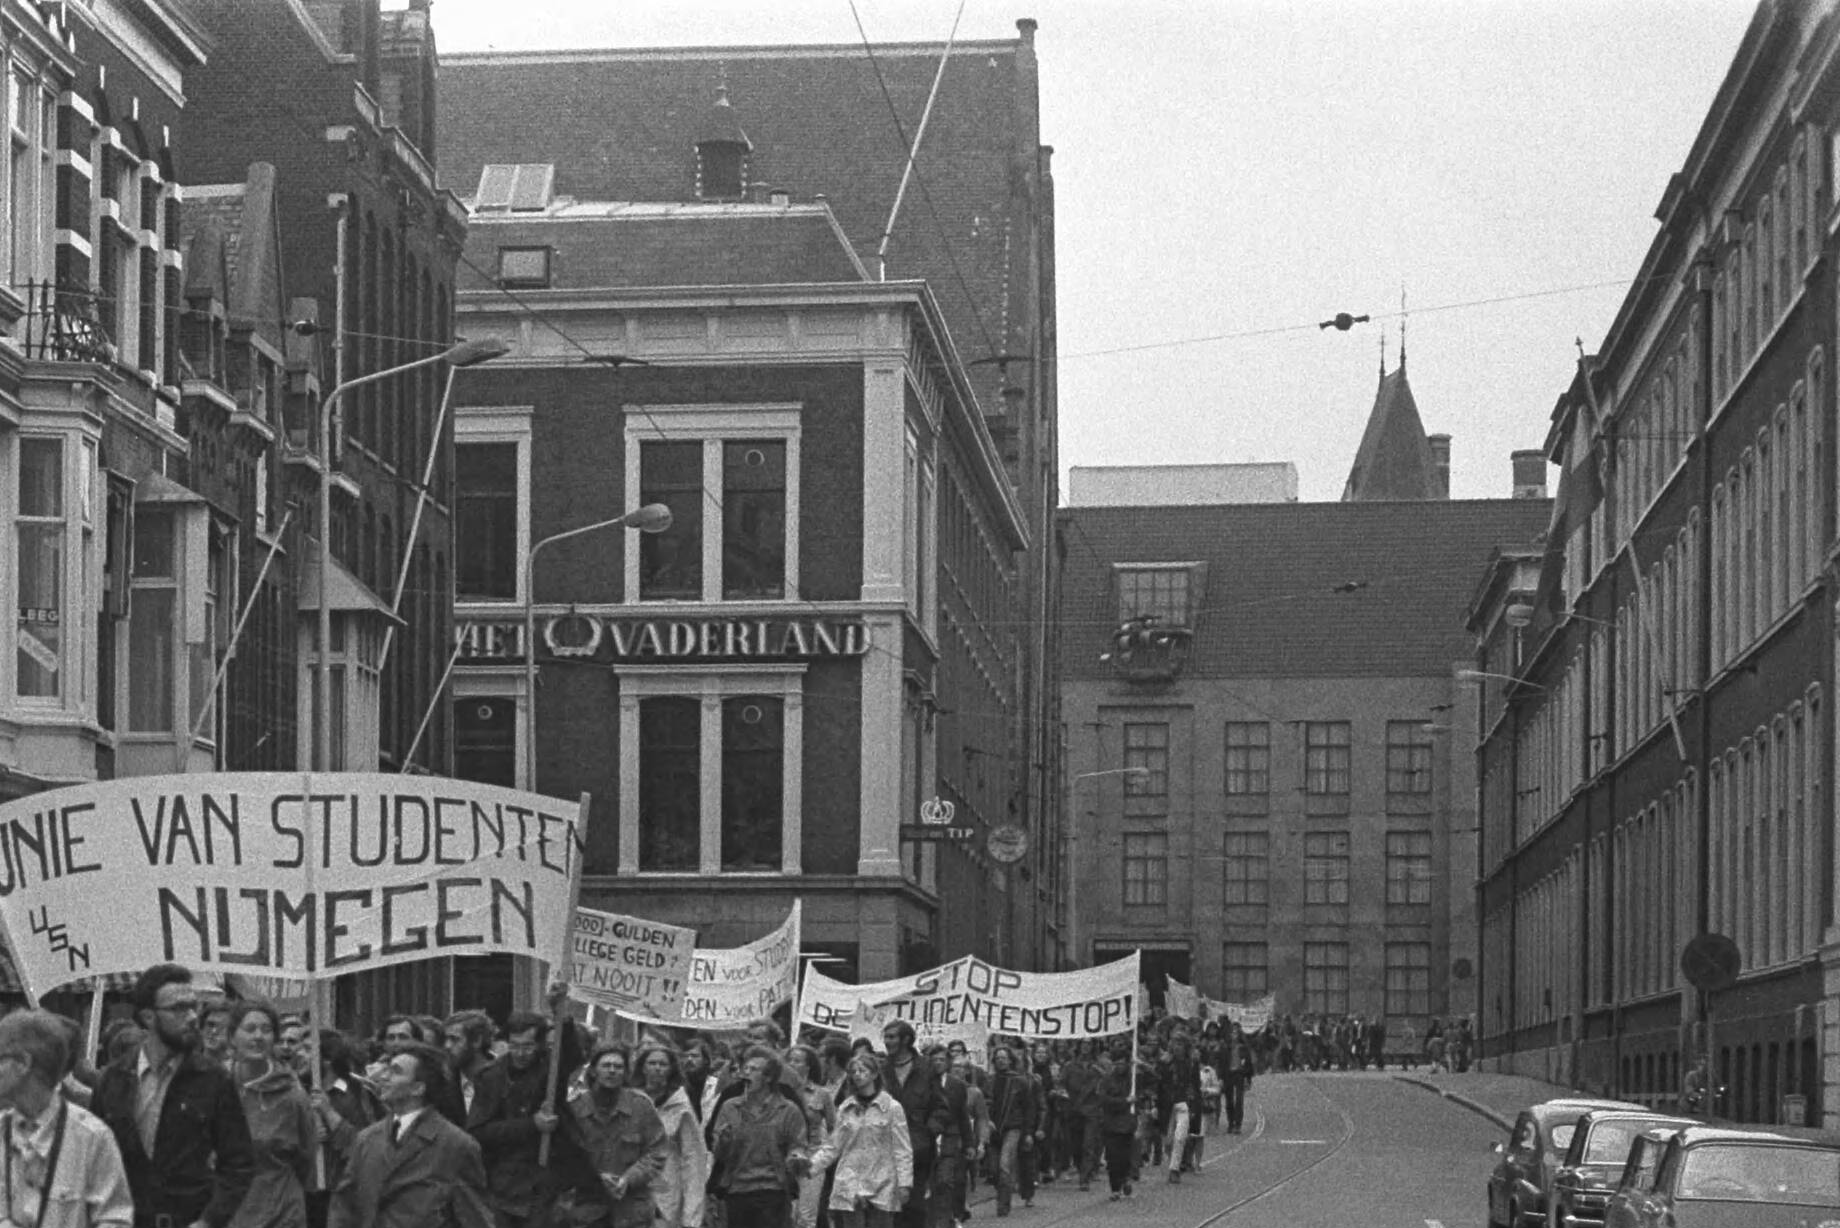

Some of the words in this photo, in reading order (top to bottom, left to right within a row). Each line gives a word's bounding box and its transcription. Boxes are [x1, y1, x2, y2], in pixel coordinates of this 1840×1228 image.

[610, 619, 872, 657] VADERLAND
[130, 793, 242, 866] VAN
[947, 827, 975, 839] TIP
[157, 878, 536, 973] NIJMEGEN
[612, 920, 676, 949] GULDEN
[623, 946, 665, 968] GELD
[593, 966, 658, 998] NOOIT
[912, 957, 1022, 998] STOP
[872, 992, 1133, 1035] TUDENTENSTOP!
